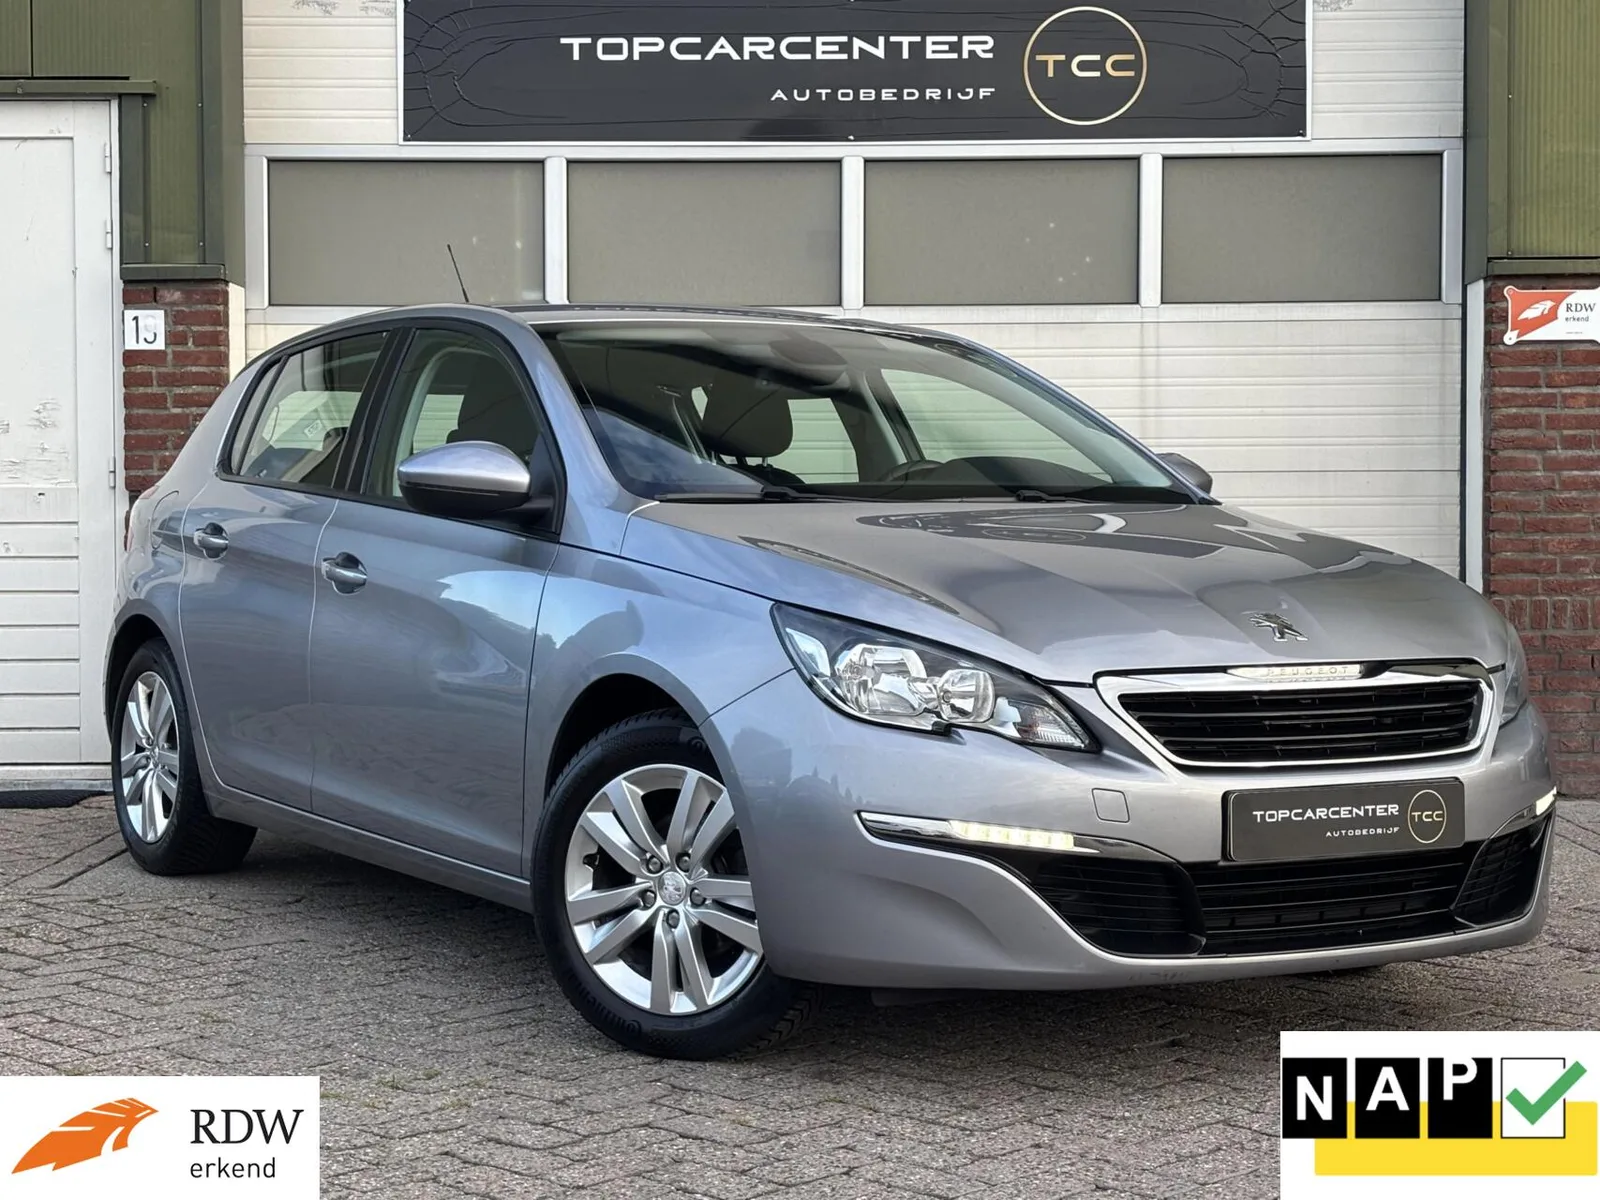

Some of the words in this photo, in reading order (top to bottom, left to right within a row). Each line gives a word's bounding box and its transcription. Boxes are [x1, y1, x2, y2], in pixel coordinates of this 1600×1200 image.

[560, 35, 994, 61] TOPCARCENTER
[1035, 54, 1136, 78] TCC
[770, 88, 996, 101] AUTOBEDRIJF
[1565, 302, 1596, 313] RDW
[1266, 666, 1349, 677] PEUGEOT
[1252, 804, 1400, 823] TOPCARCENTER
[1411, 810, 1444, 822] TCC
[1325, 826, 1400, 838] AUTOBEDRIJF
